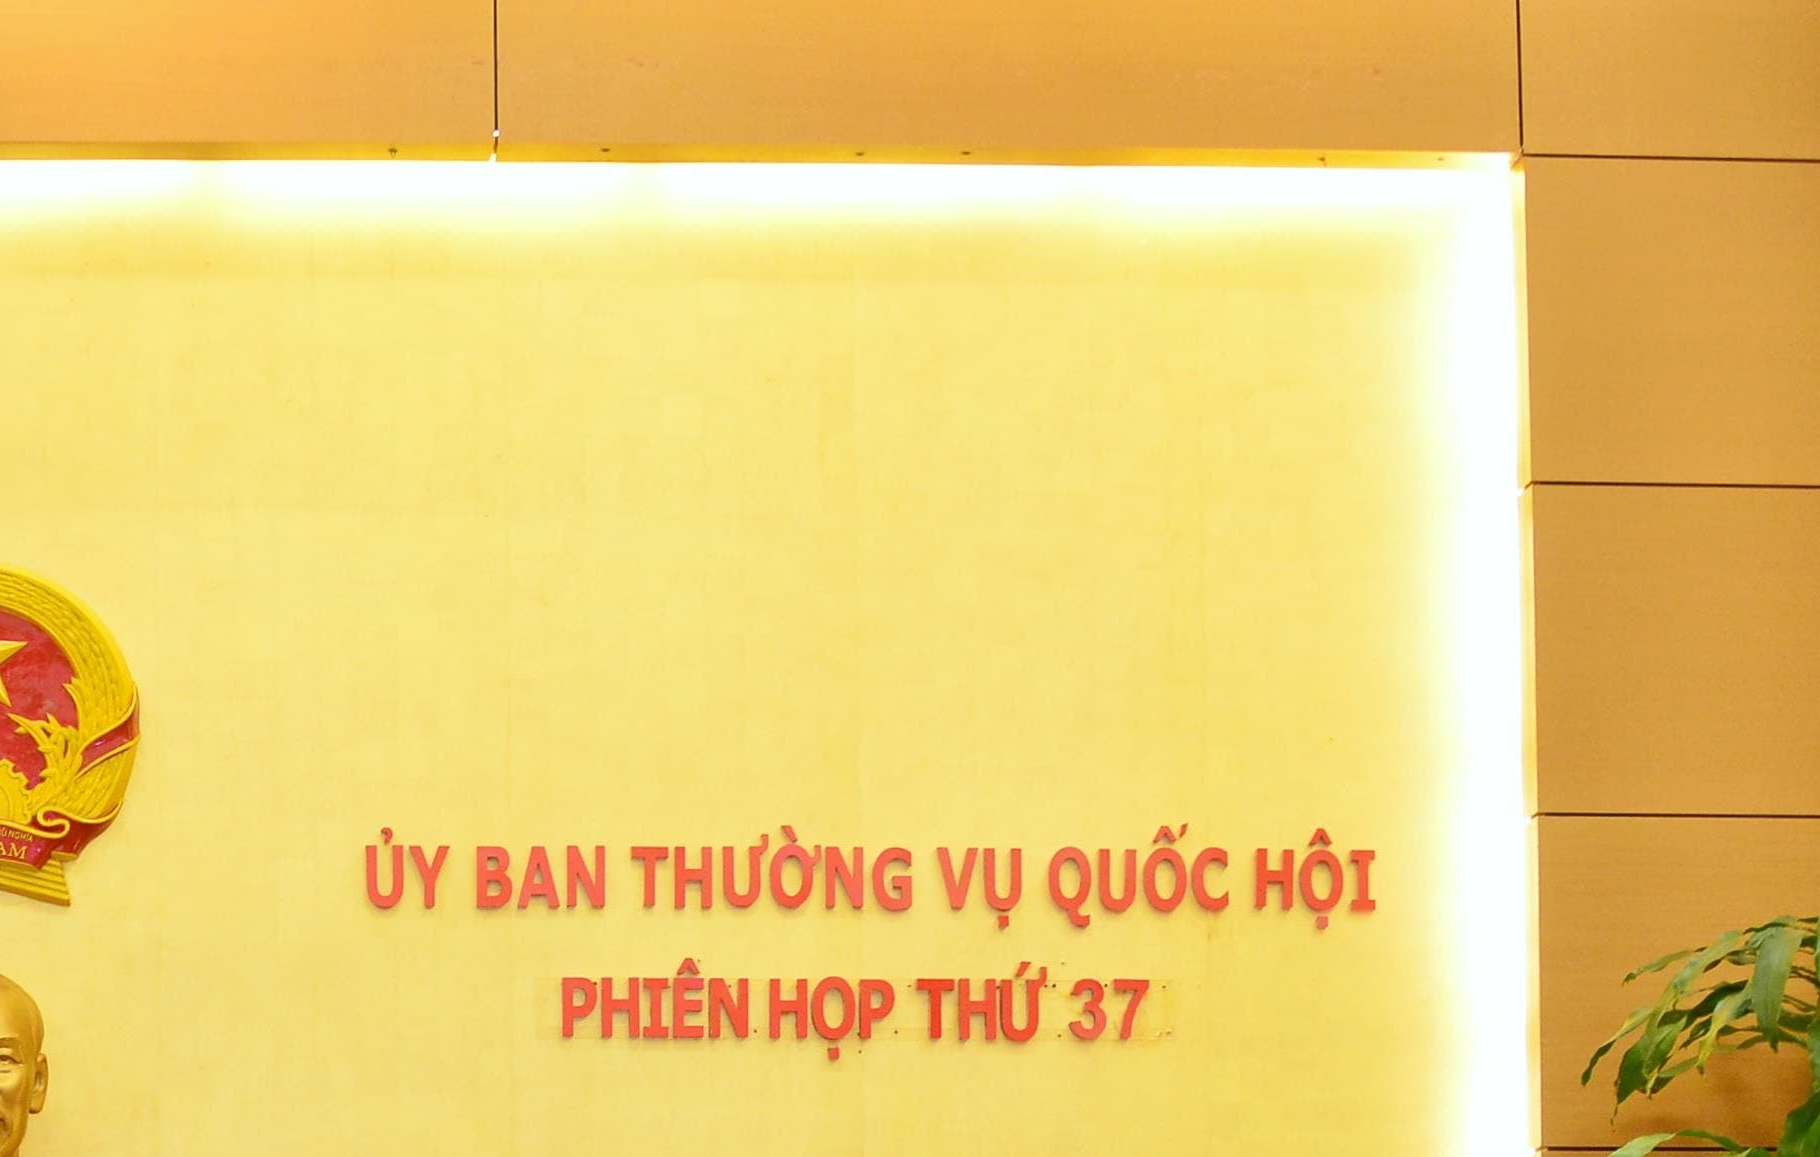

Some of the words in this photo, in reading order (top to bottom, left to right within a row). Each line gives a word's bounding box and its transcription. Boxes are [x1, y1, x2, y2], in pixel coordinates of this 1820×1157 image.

[365, 828, 448, 909] ỦY
[475, 845, 605, 909] BAN
[631, 825, 913, 912] THƯỜNG
[936, 848, 1022, 928] VỤ
[1047, 824, 1230, 928] QUỐC
[1254, 828, 1377, 930] HỘI
[561, 958, 749, 1040] PHIÊN
[768, 976, 895, 1060] HỌP
[915, 961, 1048, 1044] THỨ
[1070, 978, 1150, 1041] 37
